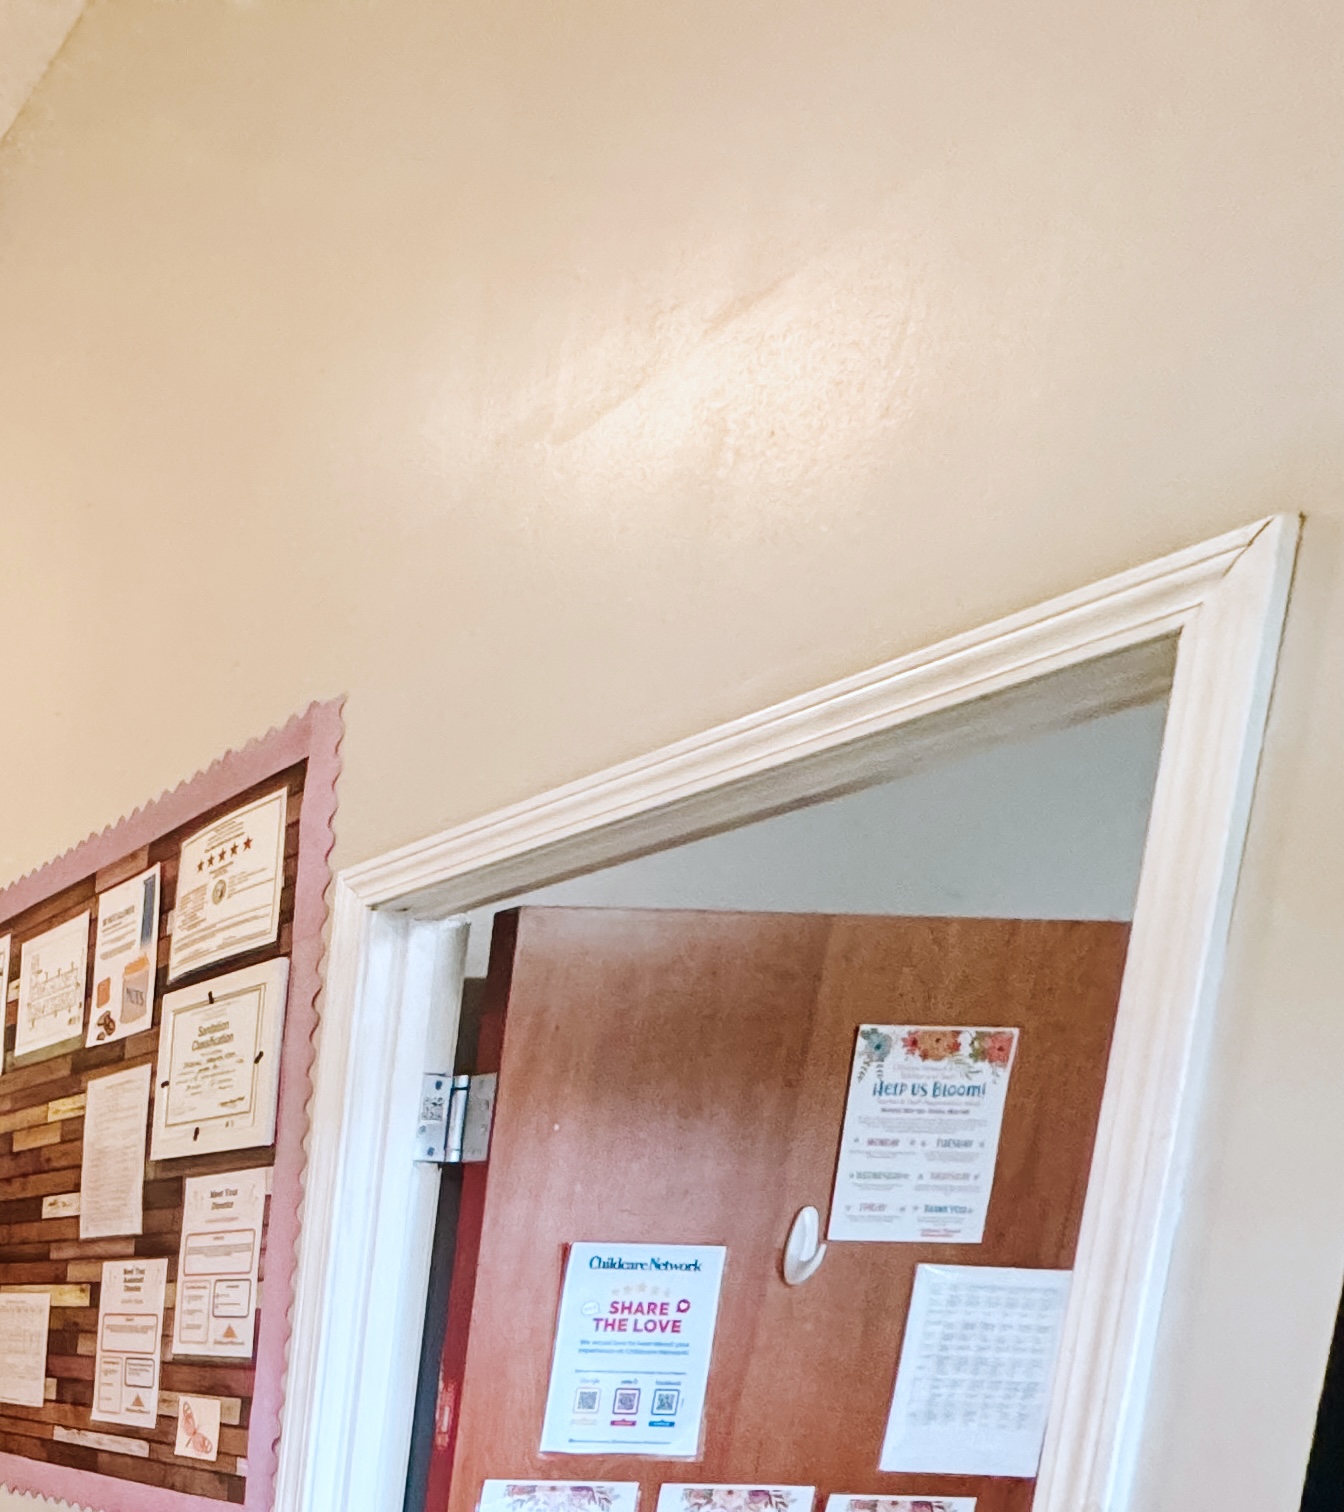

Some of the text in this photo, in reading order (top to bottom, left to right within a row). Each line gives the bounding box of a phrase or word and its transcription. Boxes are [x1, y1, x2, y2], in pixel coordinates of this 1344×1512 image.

[589, 1255, 702, 1272] Childcare Network
[609, 1300, 670, 1316] SHARE
[593, 1317, 683, 1334] THE LOVE
